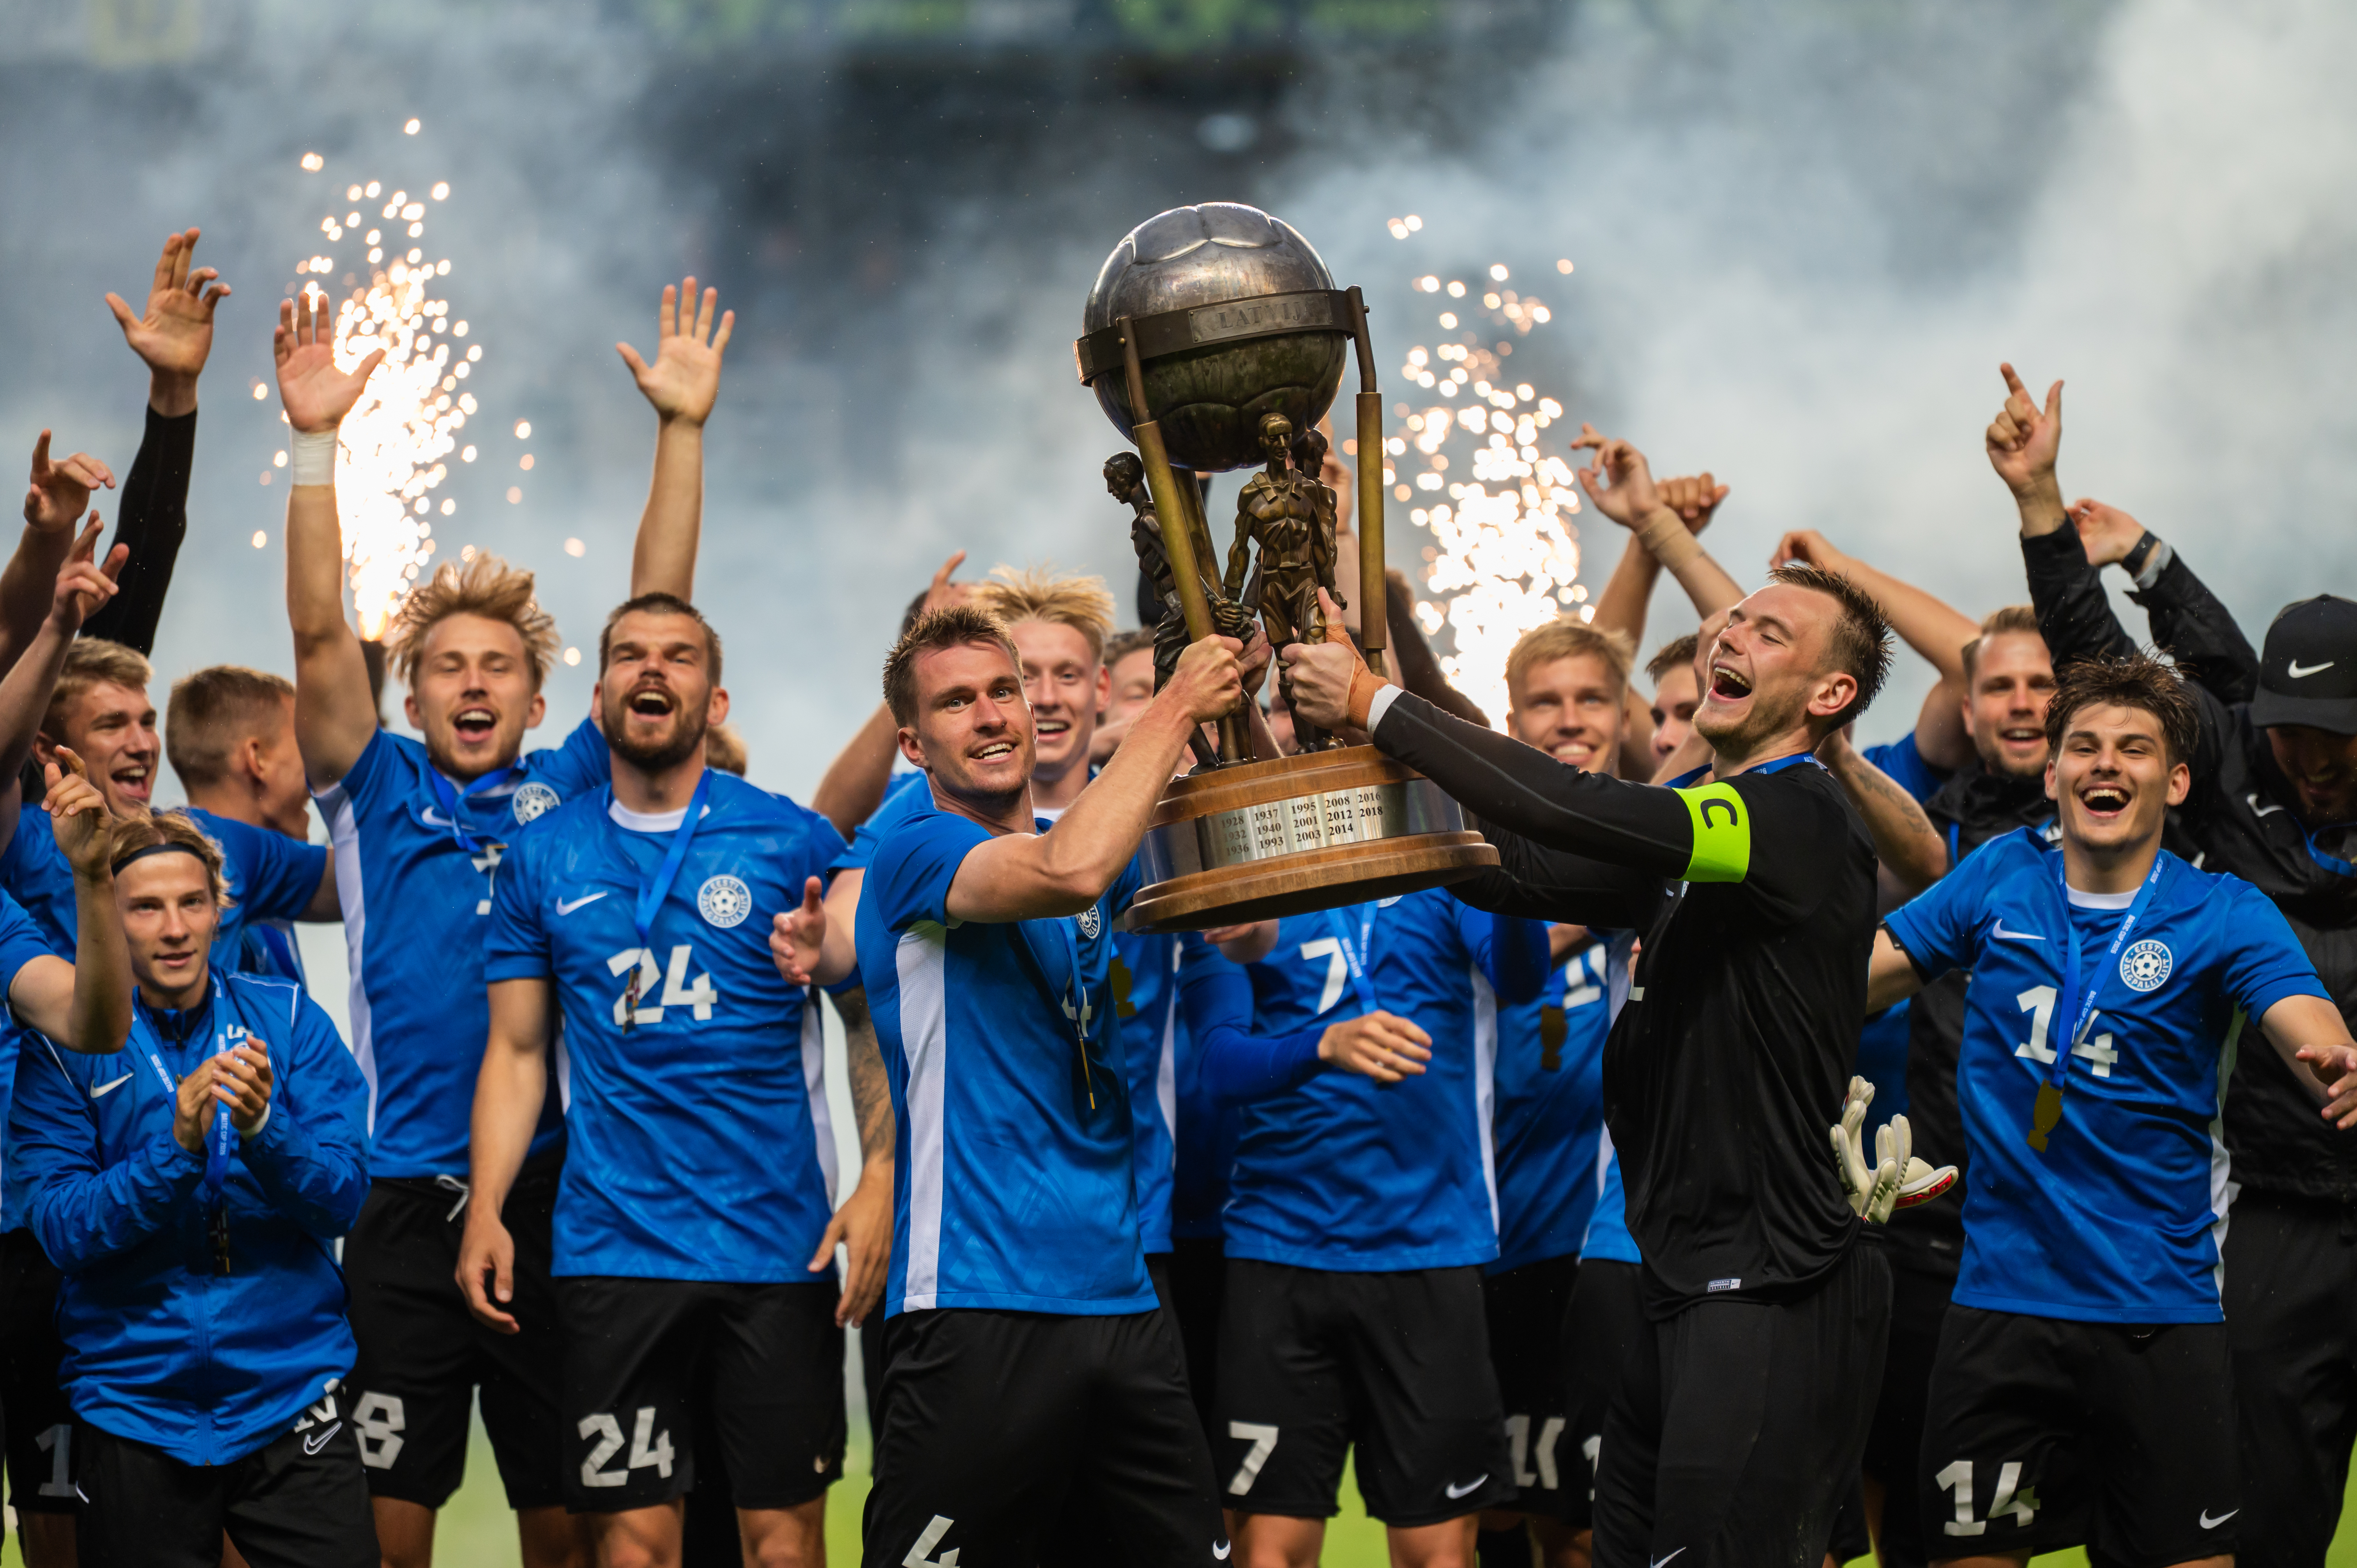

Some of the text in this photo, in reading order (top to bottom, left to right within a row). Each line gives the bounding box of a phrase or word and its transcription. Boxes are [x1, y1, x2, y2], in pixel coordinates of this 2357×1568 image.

[1218, 302, 1315, 329] LATVIJA
[1221, 792, 1381, 829] 1928 1937 1995 2008 2016
[1223, 806, 1383, 842] 1932 1940 2001 2012 2018
[1700, 798, 1738, 829] C
[1226, 823, 1353, 856] 1936 1993 2003 2014
[2134, 943, 2163, 954] EESTI
[607, 945, 717, 1026] 24
[1300, 937, 1348, 1014] 7
[2124, 957, 2159, 988] JALGPALLI
[2159, 959, 2170, 978] LIIT
[2014, 985, 2118, 1078] 14
[577, 1406, 675, 1487] 24
[1228, 1420, 1279, 1496] 7
[1935, 1460, 2041, 1536] 14
